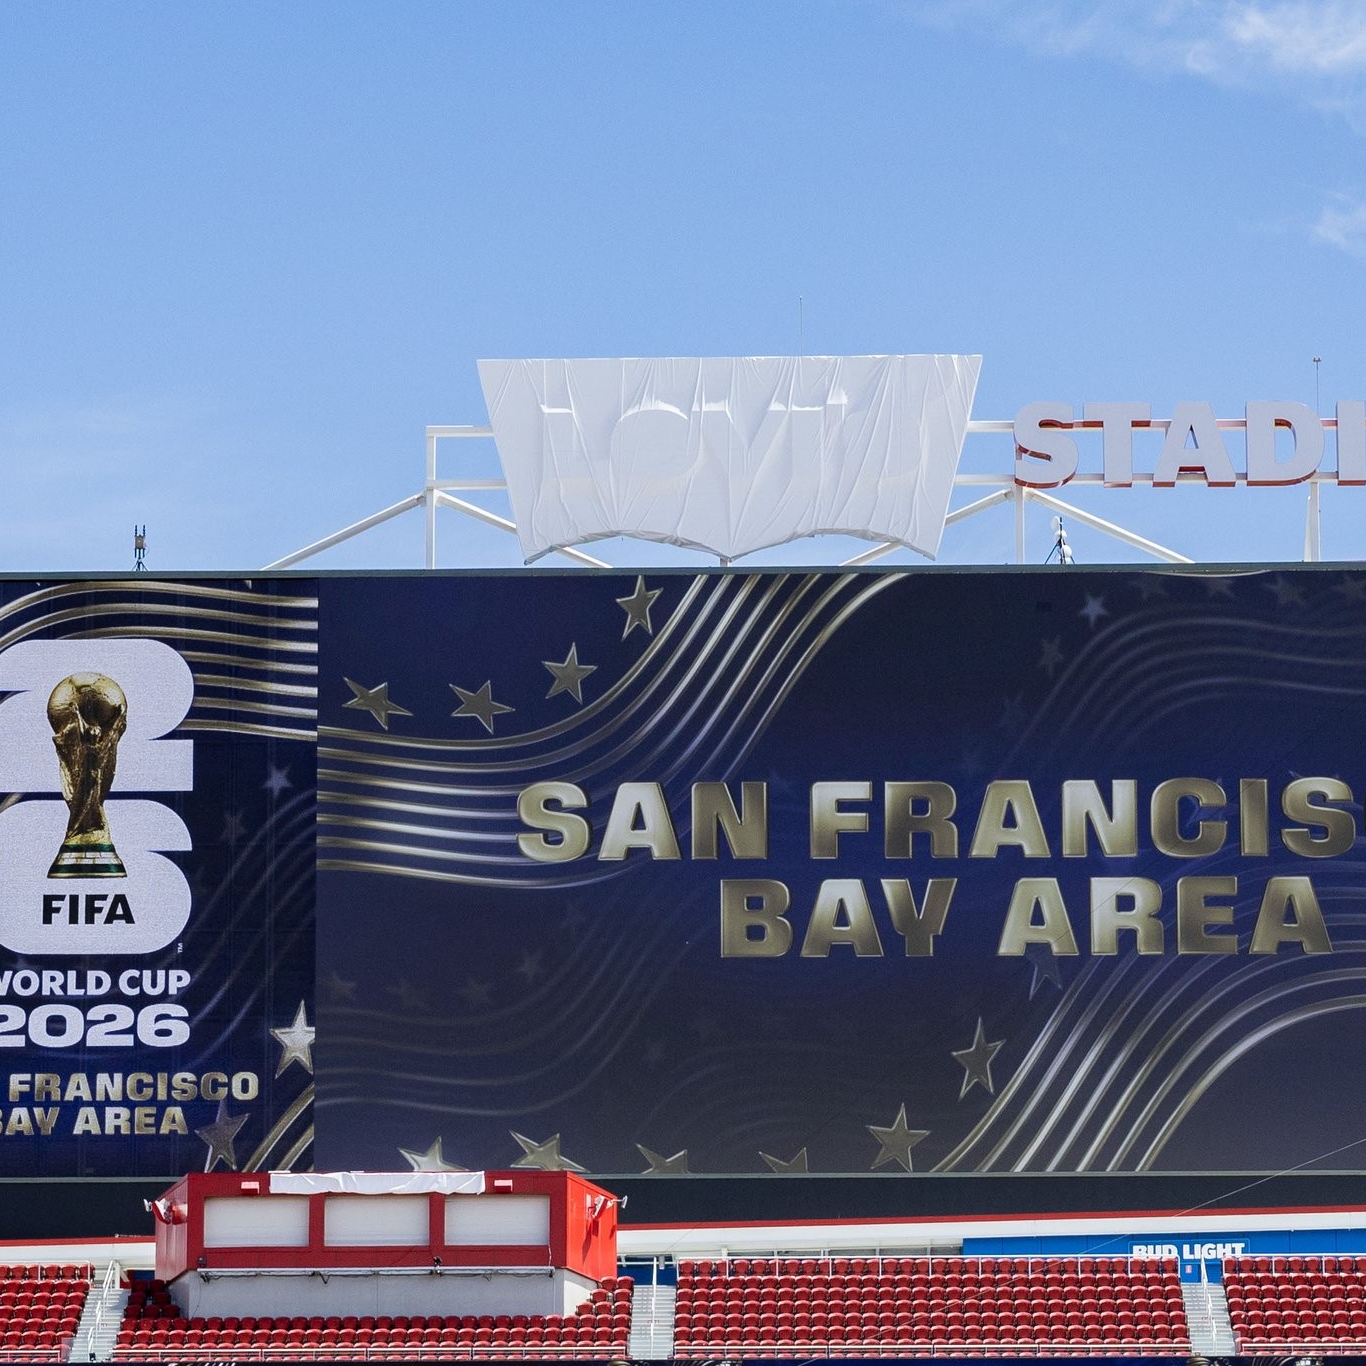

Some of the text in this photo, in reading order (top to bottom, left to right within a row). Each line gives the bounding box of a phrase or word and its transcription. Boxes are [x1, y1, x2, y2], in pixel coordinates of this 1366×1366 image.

[516, 781, 769, 863] SAN
[41, 894, 135, 925] FIFA
[719, 875, 1333, 959] BAY AREA
[119, 970, 191, 996] CUP
[8, 1072, 261, 1102] FRANCISCO
[73, 1106, 188, 1135] AREA
[1132, 1243, 1245, 1259] BUD LIGHT
